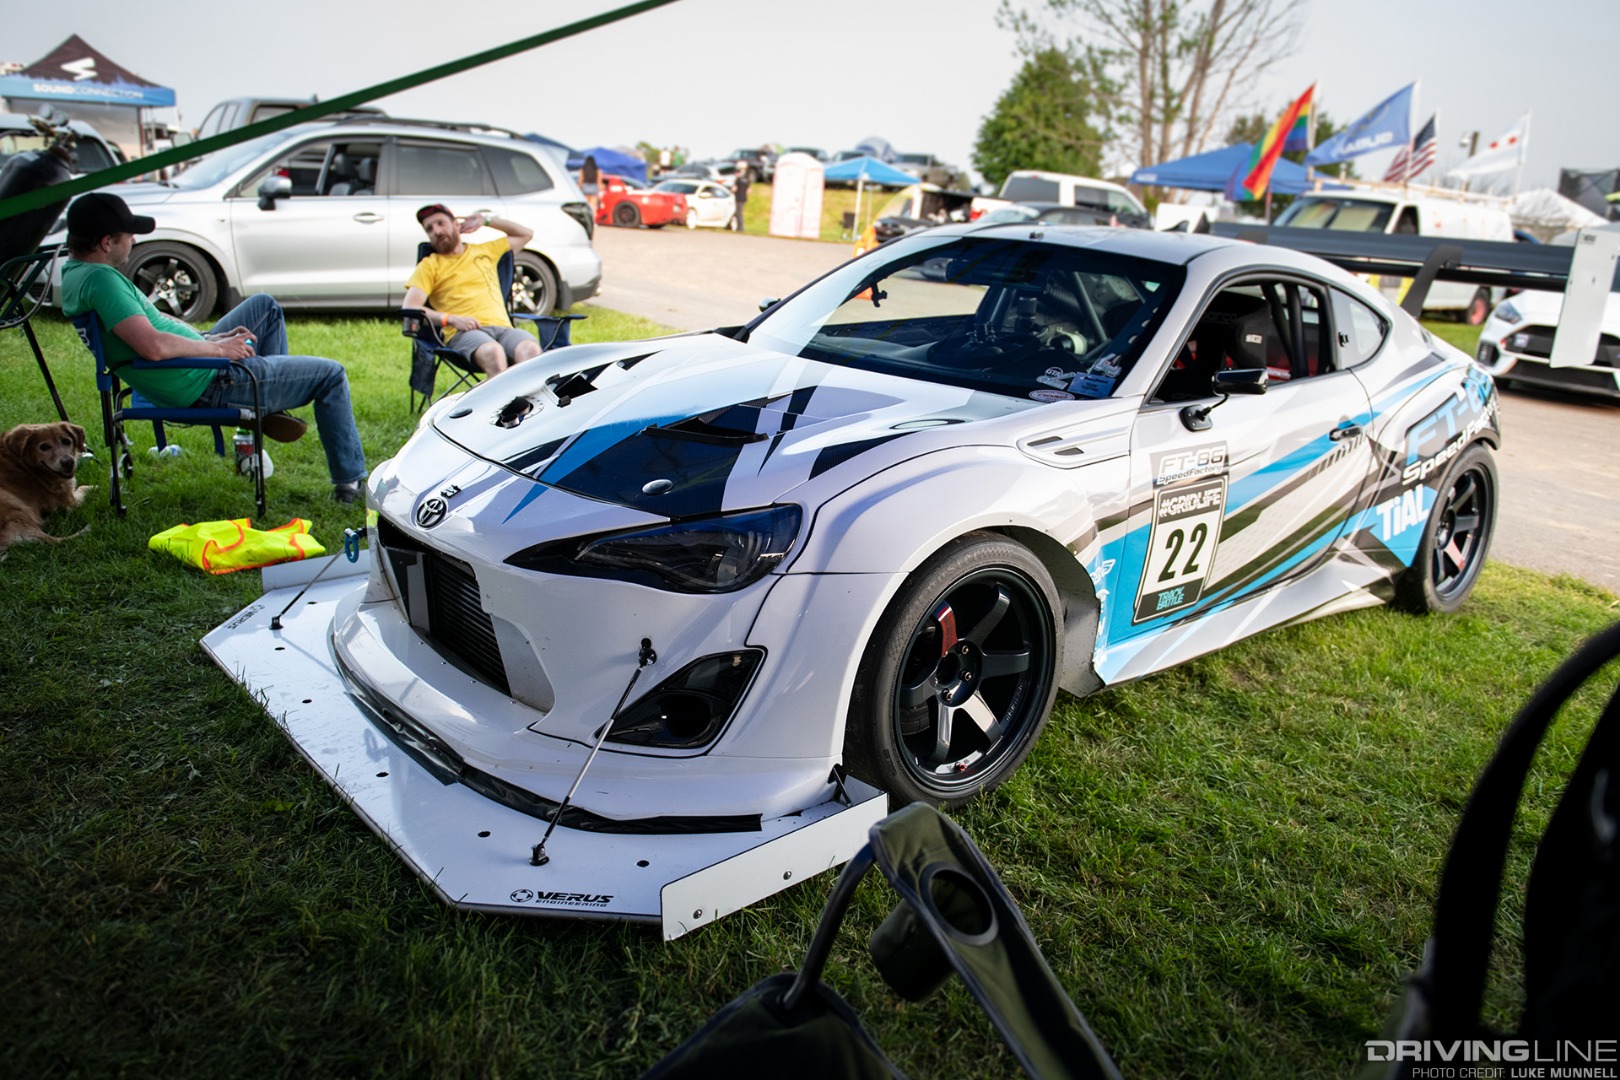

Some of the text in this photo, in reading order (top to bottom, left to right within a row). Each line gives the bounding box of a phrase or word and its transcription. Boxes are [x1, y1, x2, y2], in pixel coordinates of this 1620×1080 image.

[1160, 447, 1225, 475] FT-86
[1158, 465, 1223, 484] SpeedFactory
[1160, 488, 1221, 517] #GRIDLIFE
[1157, 523, 1208, 583] 22
[535, 899, 607, 908] ENGINEERING
[537, 890, 614, 903] VERUS
